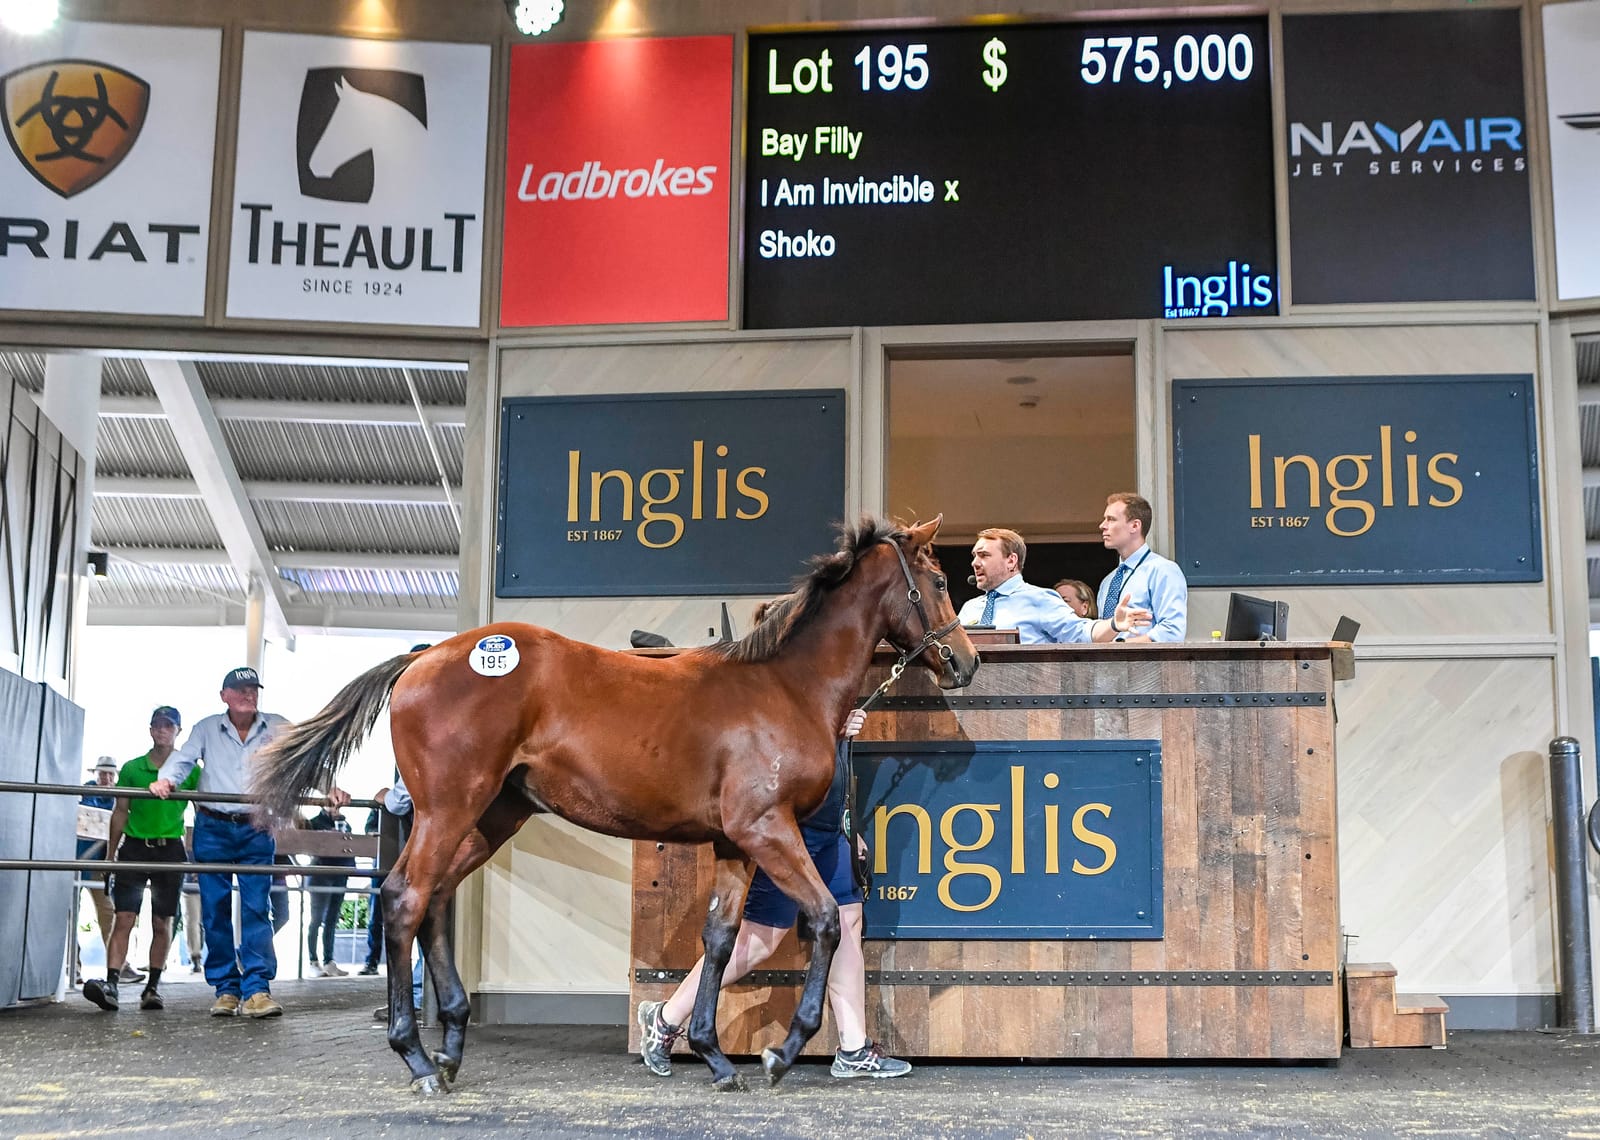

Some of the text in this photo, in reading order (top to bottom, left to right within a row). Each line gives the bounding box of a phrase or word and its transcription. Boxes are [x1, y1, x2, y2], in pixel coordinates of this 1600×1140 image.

[768, 33, 1253, 94] Lot 195 $ 575,000
[762, 126, 863, 162] Bay Filly
[1291, 117, 1523, 156] NAVAIR
[517, 158, 717, 201] Ladbrokes
[1293, 156, 1525, 176] JET SERVICES
[761, 174, 960, 207] I Am Invincible x
[0, 216, 200, 263] RIAT
[240, 202, 476, 273] THEAULT
[759, 229, 836, 258] Shoko
[302, 278, 403, 297] SINCE 1924
[1164, 261, 1272, 317] Inglis
[567, 440, 769, 549] Inglis
[1248, 425, 1464, 537] Inglis
[567, 529, 623, 542] EST 1867
[1251, 516, 1311, 528] EST 1867
[480, 655, 507, 669] 195
[873, 765, 1118, 912] nglis
[877, 886, 918, 900] 1867
